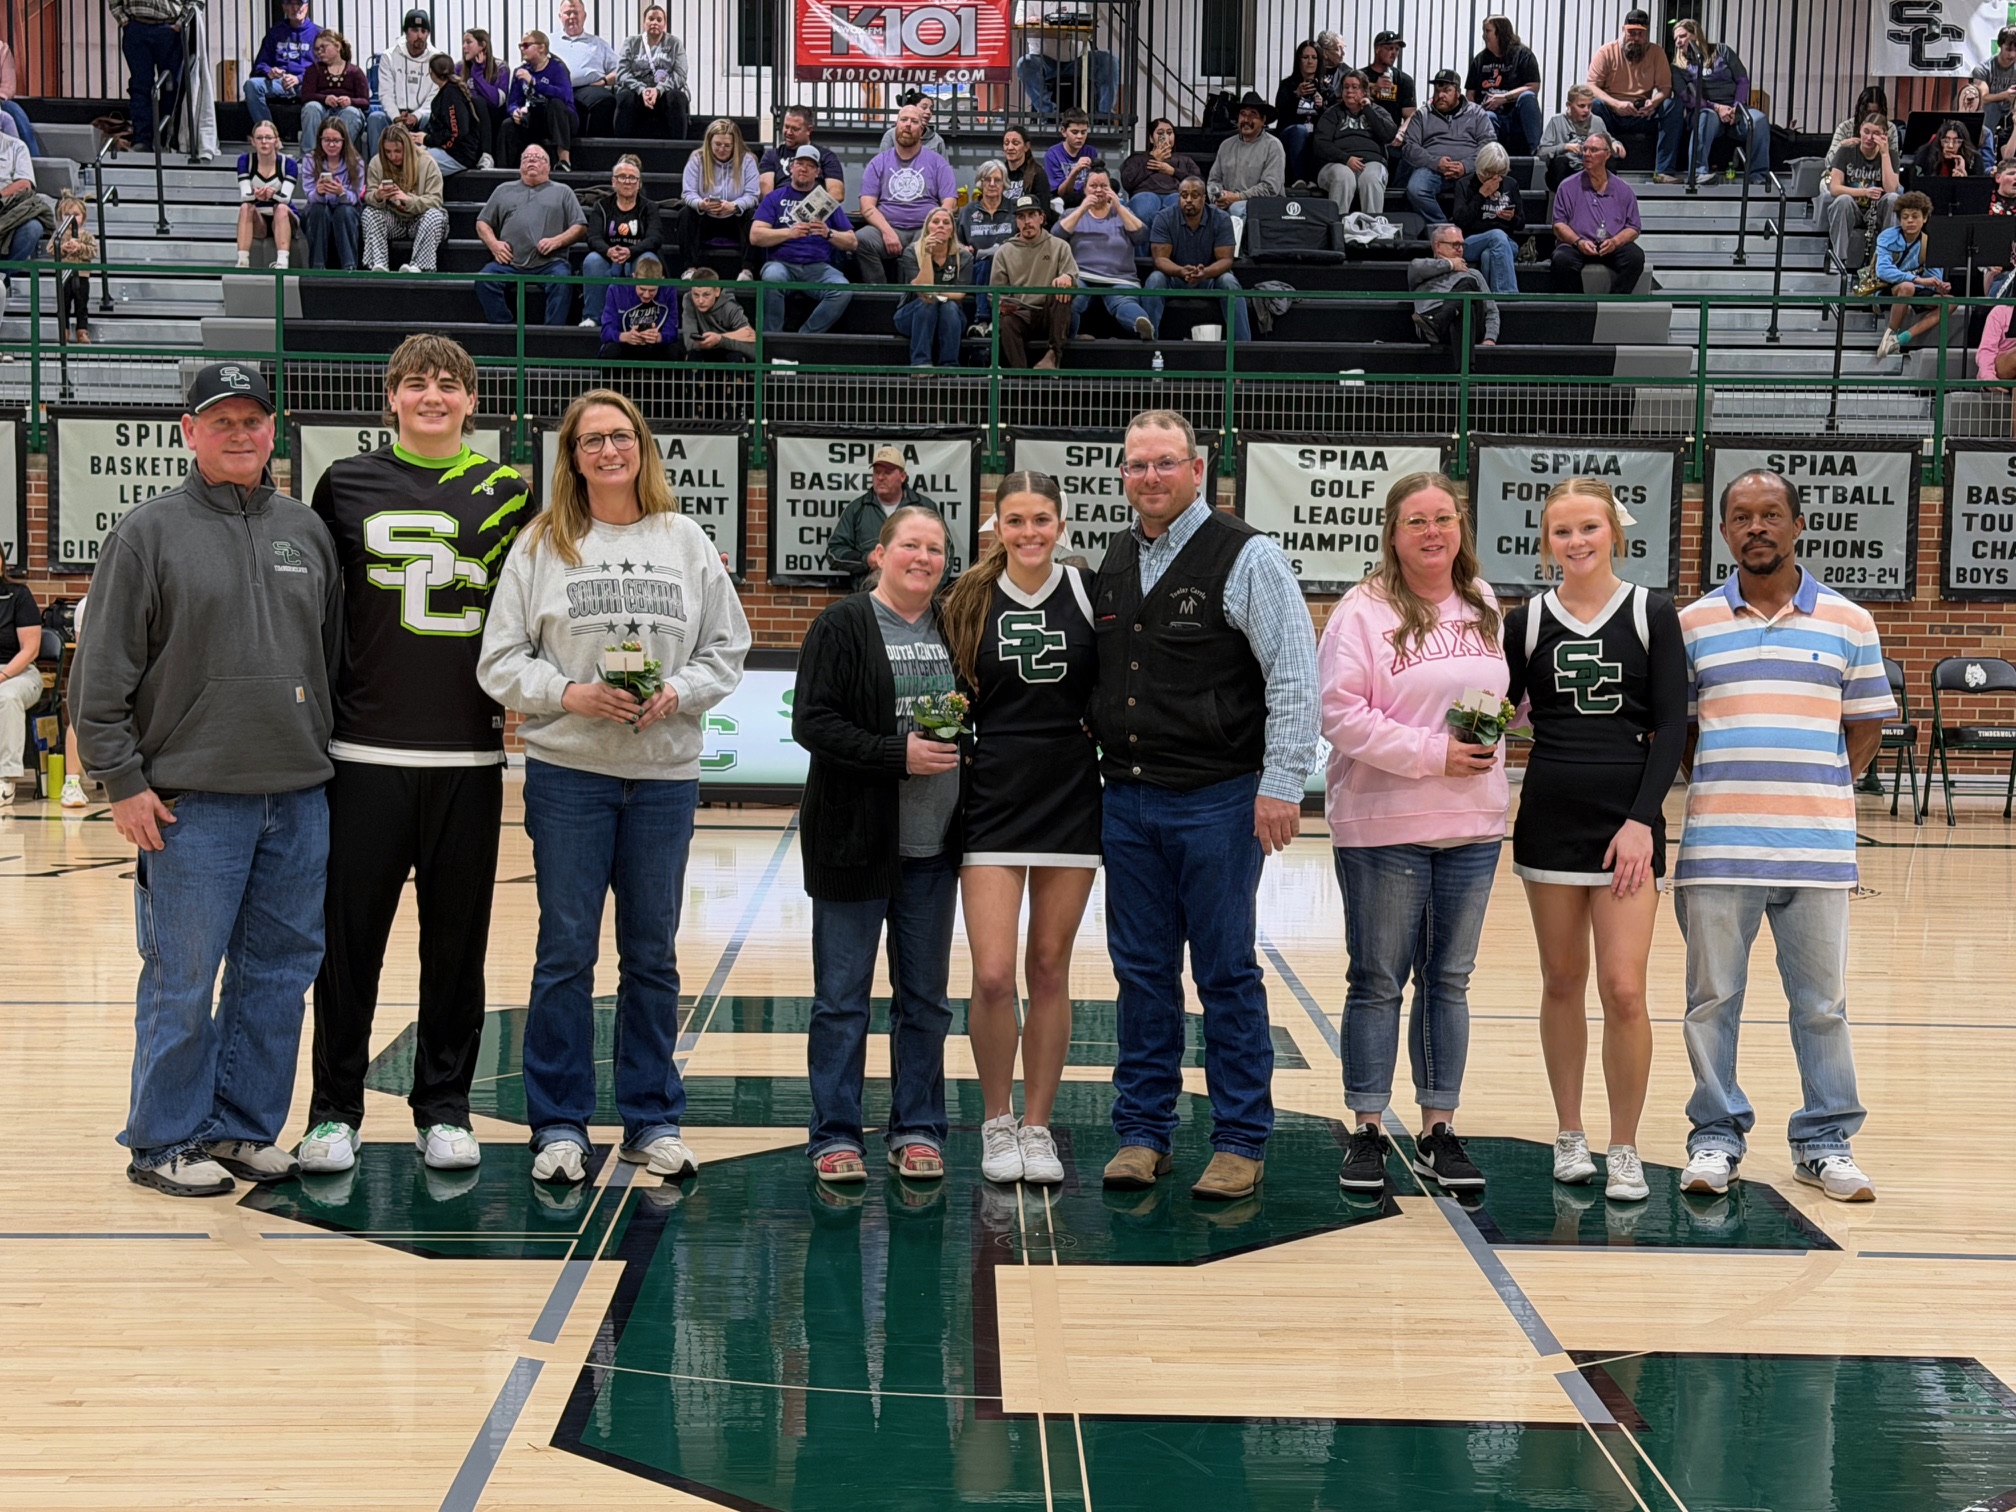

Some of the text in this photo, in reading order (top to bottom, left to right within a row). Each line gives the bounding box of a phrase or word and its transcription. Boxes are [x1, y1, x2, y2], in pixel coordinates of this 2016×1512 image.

[830, 5, 979, 58] K101
[1886, 0, 1965, 71] SC
[822, 67, 986, 82] K101ONLINE.COM
[220, 366, 251, 390] SC
[116, 423, 183, 448] SPIA
[828, 442, 920, 465] SPIA
[1298, 448, 1389, 471] SPIAA
[1530, 452, 1622, 476] SPIAA
[1766, 454, 1858, 476] SPIAA
[90, 455, 188, 477] BASKETB
[1311, 479, 1375, 499] GOLF
[677, 496, 729, 515] ENT
[1294, 505, 1386, 526] LEAGUE
[363, 510, 489, 637] SC
[1823, 566, 1899, 584] 2023-24
[1956, 567, 2009, 584] BOYS
[566, 578, 622, 619] SOUTH
[997, 610, 1068, 683] SC
[1553, 639, 1622, 714] SC
